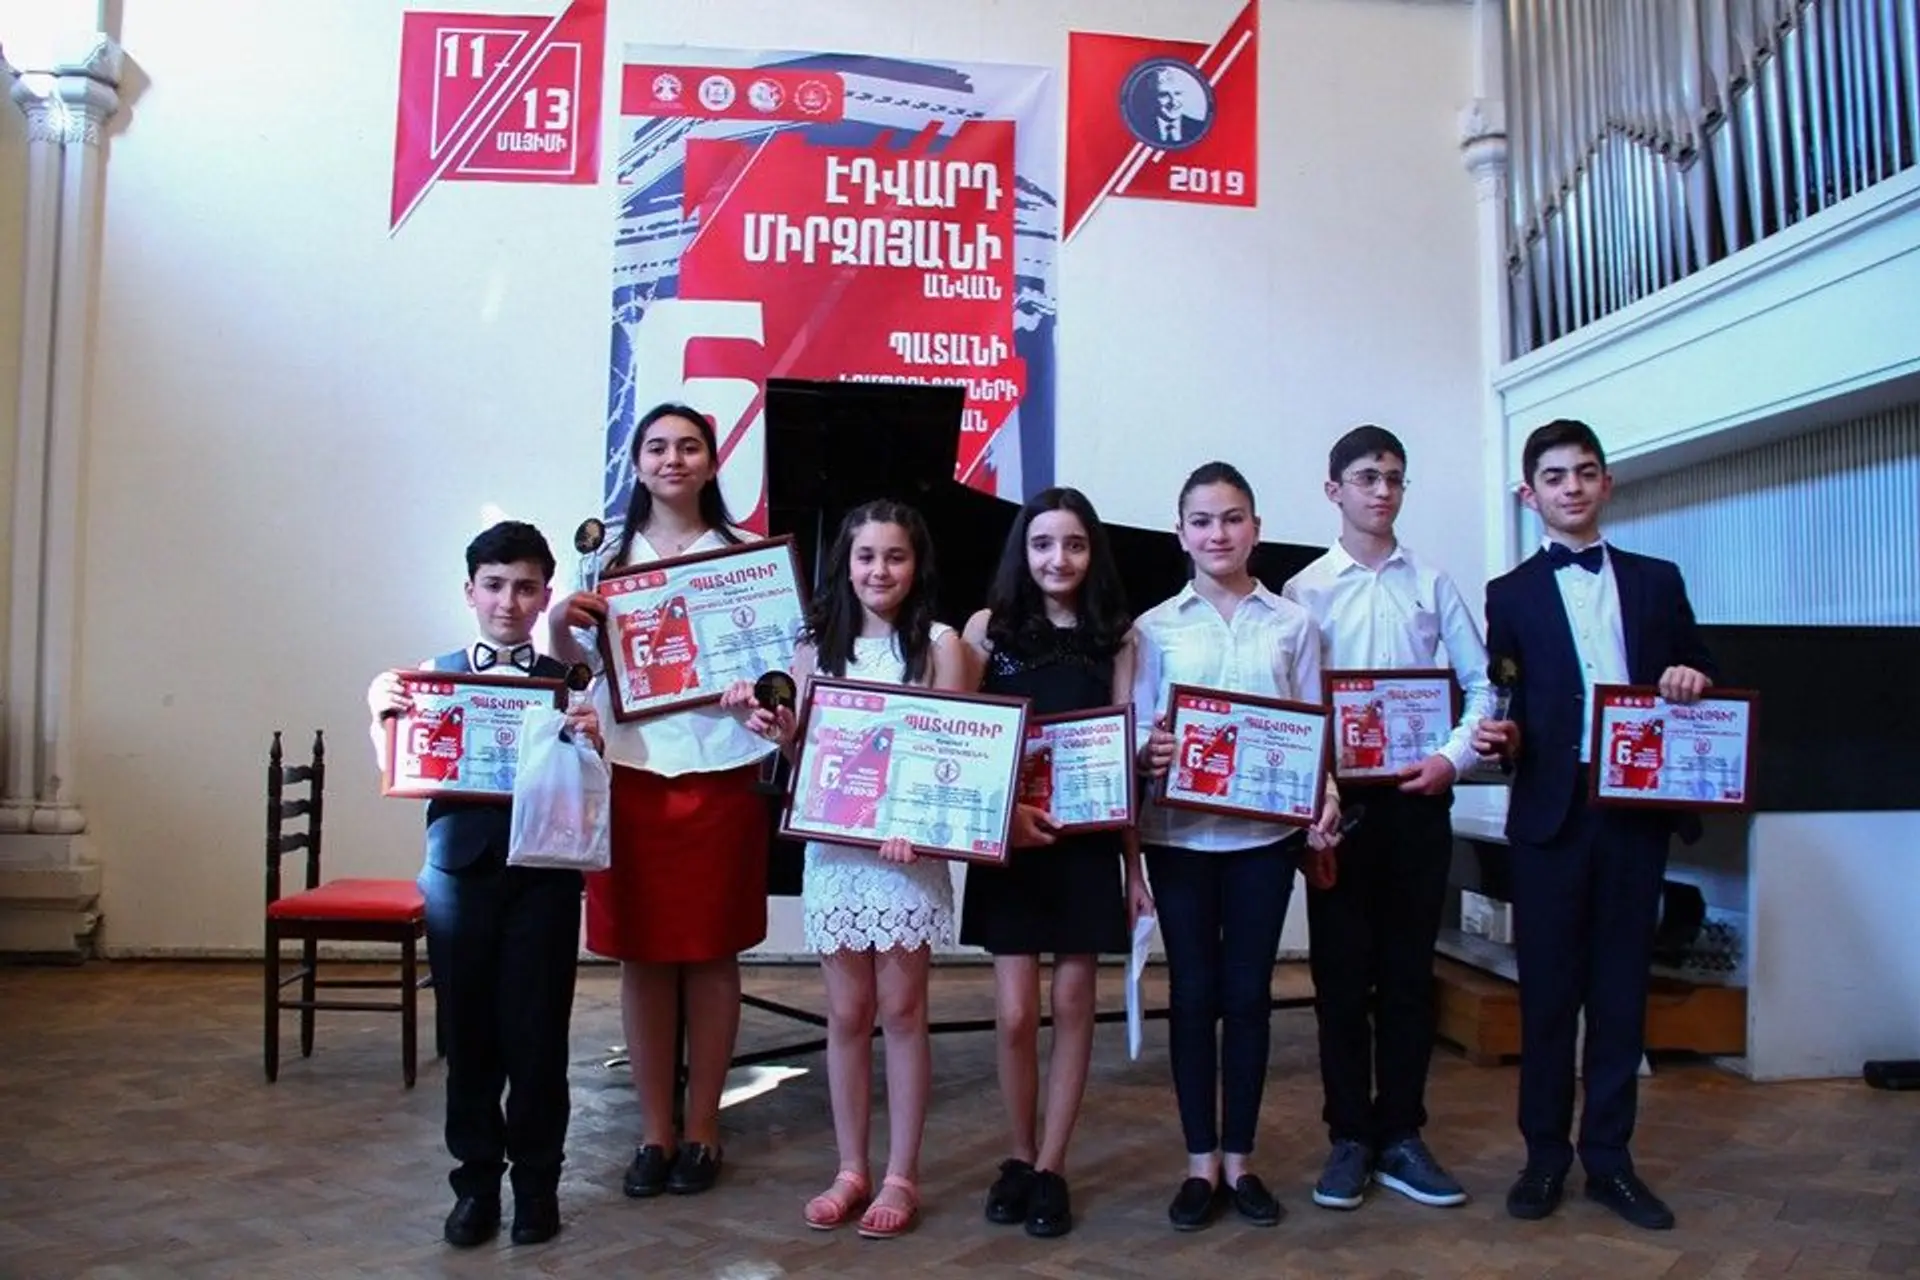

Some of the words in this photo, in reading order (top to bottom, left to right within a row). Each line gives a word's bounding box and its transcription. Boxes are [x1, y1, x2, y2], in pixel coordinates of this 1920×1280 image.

[444, 34, 486, 79] 11
[523, 88, 571, 130] 13
[496, 131, 567, 153] ՄԱՅԻՍԻ
[824, 155, 1004, 212] ԷԴՎԱՐԴ
[1168, 165, 1245, 196] 2019
[742, 212, 1003, 271] ՄԻՐԶՈՅԱՆԻ
[923, 273, 1003, 301] ԱՆՎԱՆ
[889, 331, 1009, 367] ՊԱՏԱՆԻ
[689, 562, 778, 592] ՊԱՏՎՈԳԻՐ
[903, 713, 1004, 739] ՊԱՏՎՈԳԻՐ
